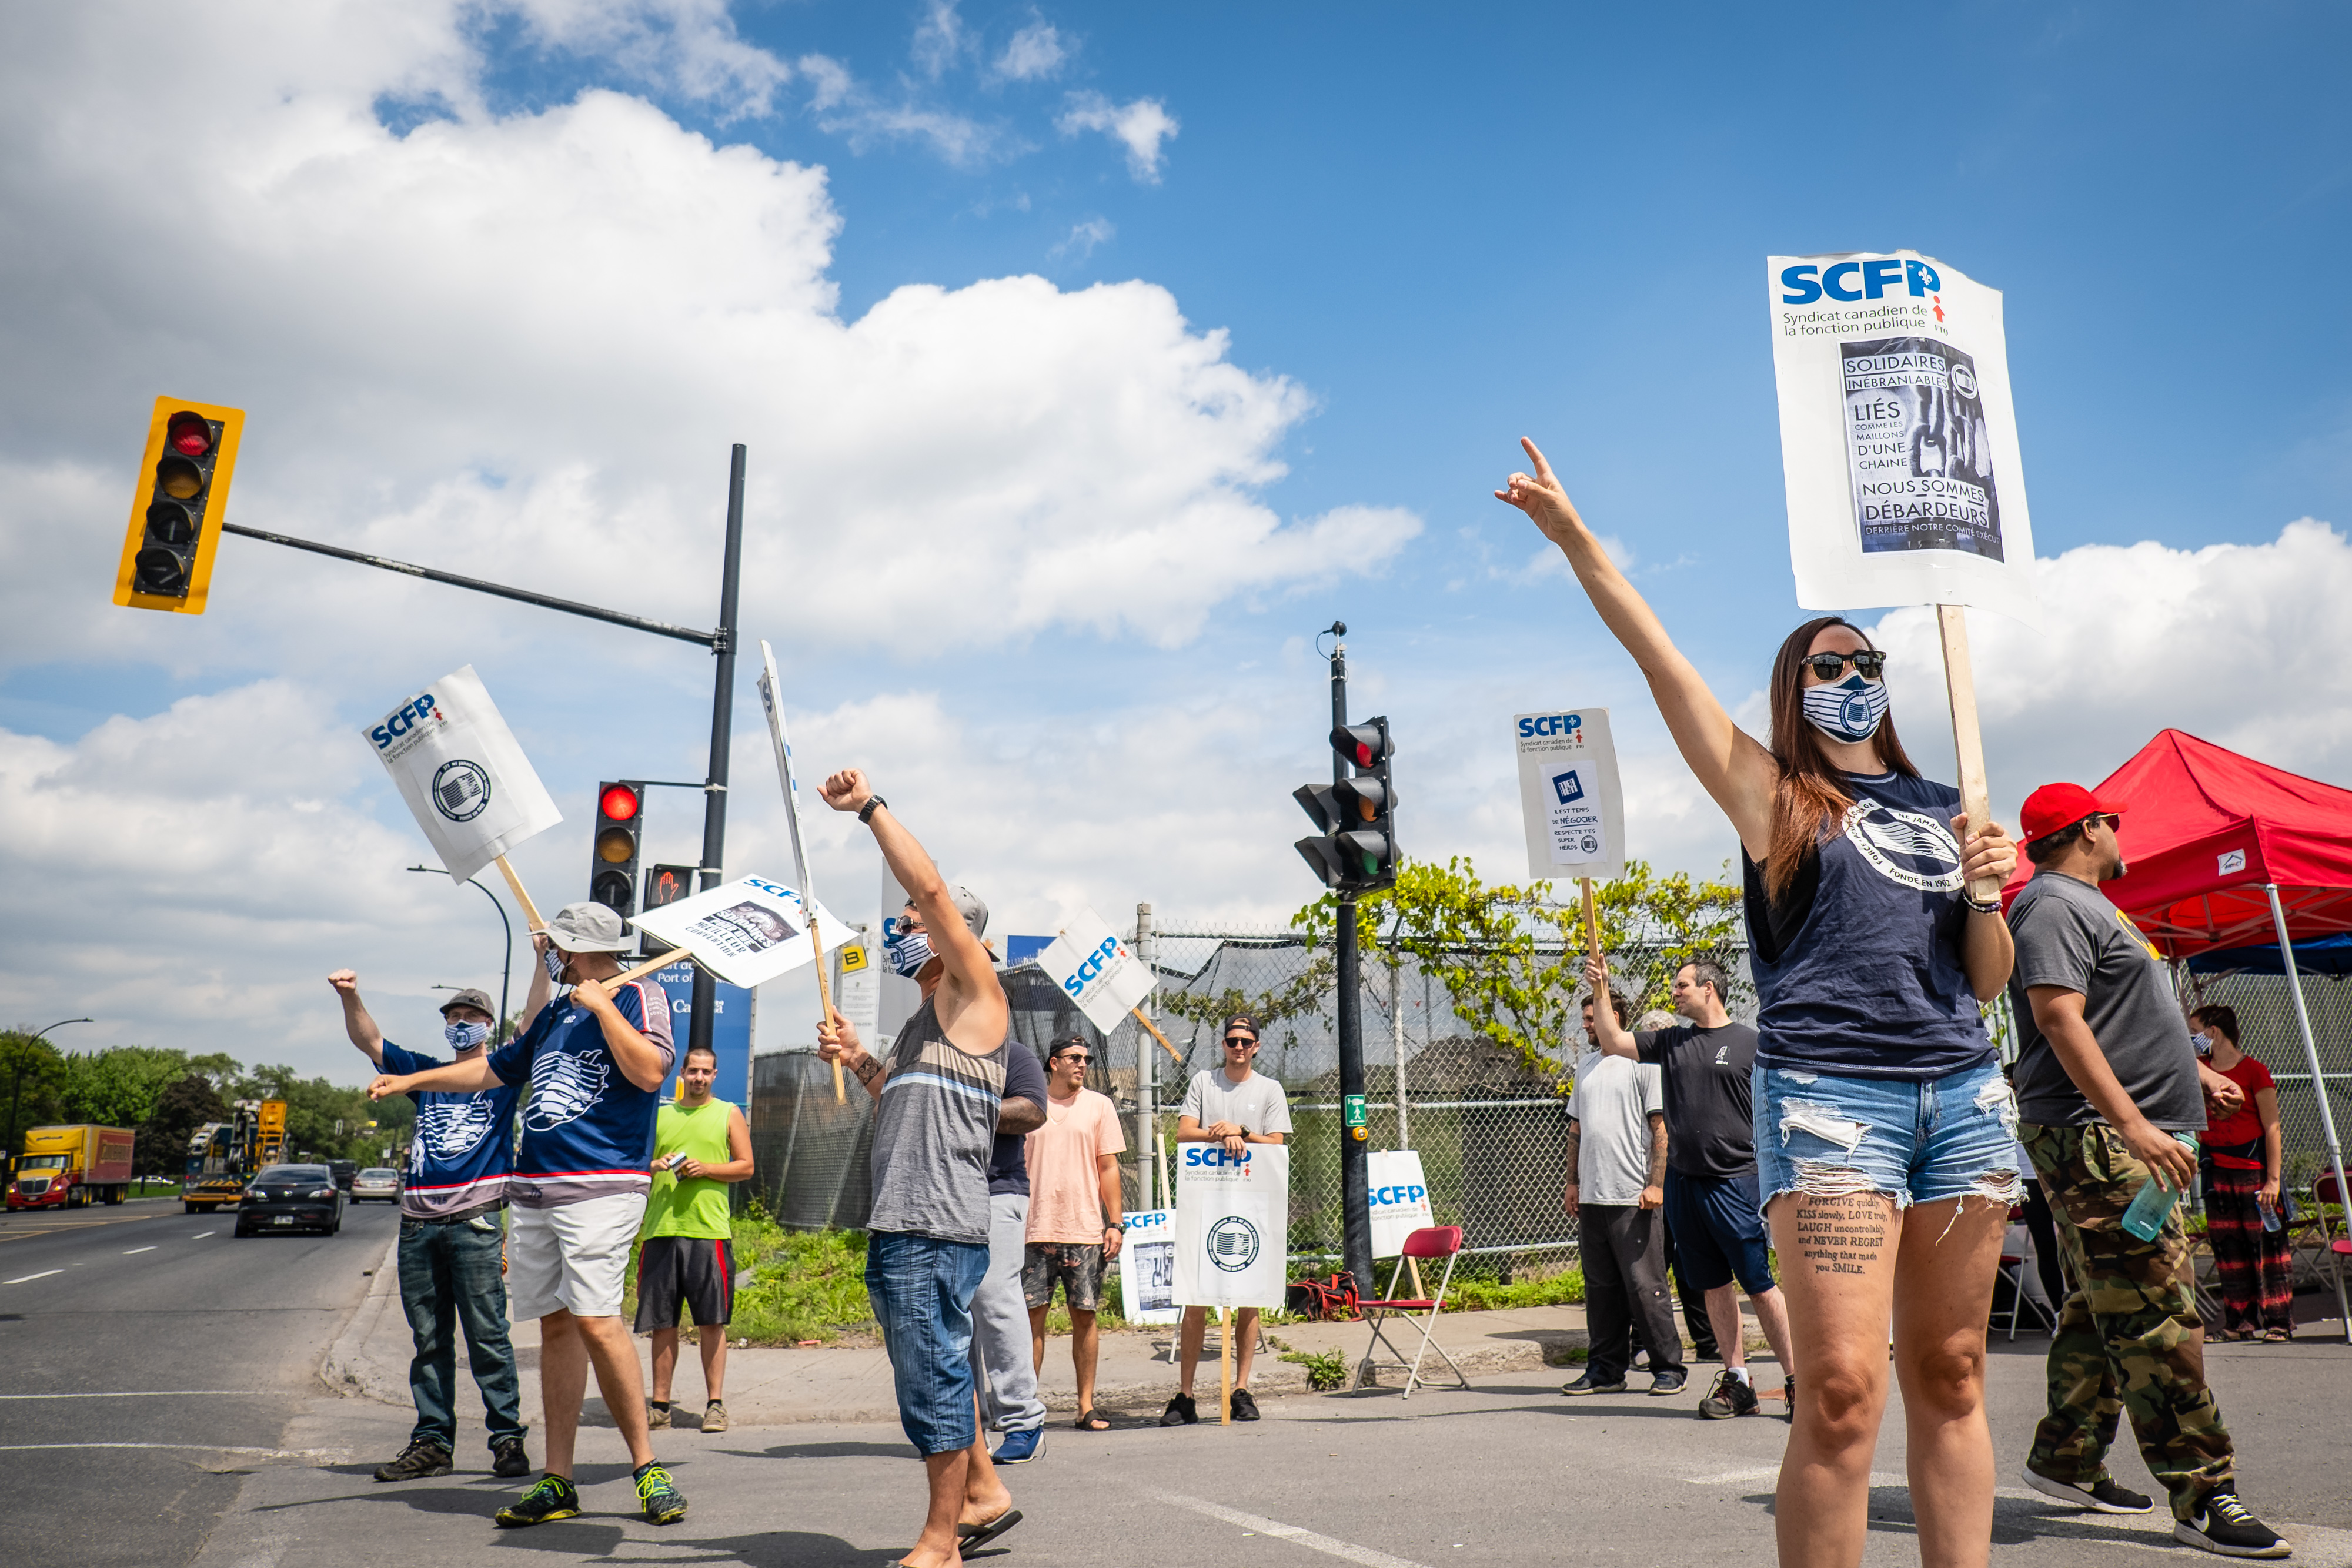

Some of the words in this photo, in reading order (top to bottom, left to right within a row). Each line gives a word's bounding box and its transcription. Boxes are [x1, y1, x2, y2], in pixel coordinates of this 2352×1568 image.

[1781, 259, 1941, 305] SCFP
[1783, 310, 1840, 325] Syndicat
[1845, 305, 1908, 320] canadien
[1912, 305, 1927, 316] de
[1785, 325, 1796, 336] la
[1800, 320, 1859, 335] fonction
[1864, 317, 1925, 333] publique
[1935, 323, 1949, 336] FTQ
[1846, 355, 1945, 373] SOLIDAIRES
[1847, 375, 1948, 390] INÉBRANLABLES
[1855, 398, 1900, 422] LIÉS
[1855, 422, 1888, 430] COMME
[1890, 420, 1903, 429] LES
[1856, 430, 1904, 441] MAILLONS
[1858, 442, 1906, 456] D'UNE
[1859, 457, 1907, 470] CHAINE
[1863, 480, 1916, 496] NOUS
[1921, 479, 1984, 503] SOMMES
[1865, 500, 1988, 527] DÉBARDEURS
[1866, 524, 1909, 535] DERRIÈRE
[1912, 523, 1943, 532] NOTRE
[1946, 524, 1975, 536] COMITÉ
[371, 694, 435, 750] SCFP
[1519, 714, 1581, 738] SCFP
[383, 741, 405, 760] Syndicat
[405, 726, 426, 744] canadien
[392, 743, 415, 760] fonction
[413, 728, 436, 747] publique
[1560, 815, 1598, 824] NÉGOCIER
[1889, 867, 1919, 884] FONDÉ
[1921, 880, 1933, 888] EN
[1935, 879, 1952, 888] 1902
[743, 879, 818, 910] SCF
[694, 921, 747, 954] MEILLEUR
[710, 918, 736, 933] POUR
[734, 929, 756, 947] UNE
[685, 925, 737, 958] CONVENTION
[844, 951, 860, 966] B
[664, 962, 678, 971] ort
[883, 962, 888, 974] la
[1065, 937, 1117, 997] SCFP
[658, 972, 679, 983] Port
[682, 972, 694, 983] of
[1077, 985, 1097, 1005] Syndicat
[1096, 965, 1115, 987] canadien
[1087, 984, 1106, 1004] fonction
[1105, 965, 1124, 987] publique
[672, 999, 724, 1014] Caa
[1369, 1185, 1424, 1206] SCFP
[1809, 1197, 1854, 1206] FORGIVE
[1856, 1199, 1880, 1209] quickly,
[1123, 1213, 1166, 1228] SCFP
[1796, 1209, 1817, 1219] KISS
[1818, 1210, 1845, 1221] slowly,
[1848, 1211, 1872, 1220] LOVE
[1874, 1212, 1887, 1221] truly,
[1798, 1222, 1832, 1233] LAUGH
[1834, 1224, 1885, 1235] uncontrollably,
[1798, 1236, 1810, 1245] and
[1813, 1236, 1847, 1246] NEVER
[1850, 1236, 1883, 1247] REGRET
[1804, 1249, 1838, 1262] anything
[1840, 1251, 1856, 1260] that
[1858, 1252, 1877, 1261] made
[1815, 1265, 1830, 1274] you
[1832, 1263, 1866, 1275] SMILE.
[1141, 1293, 1171, 1302] DÉBARDEUR
